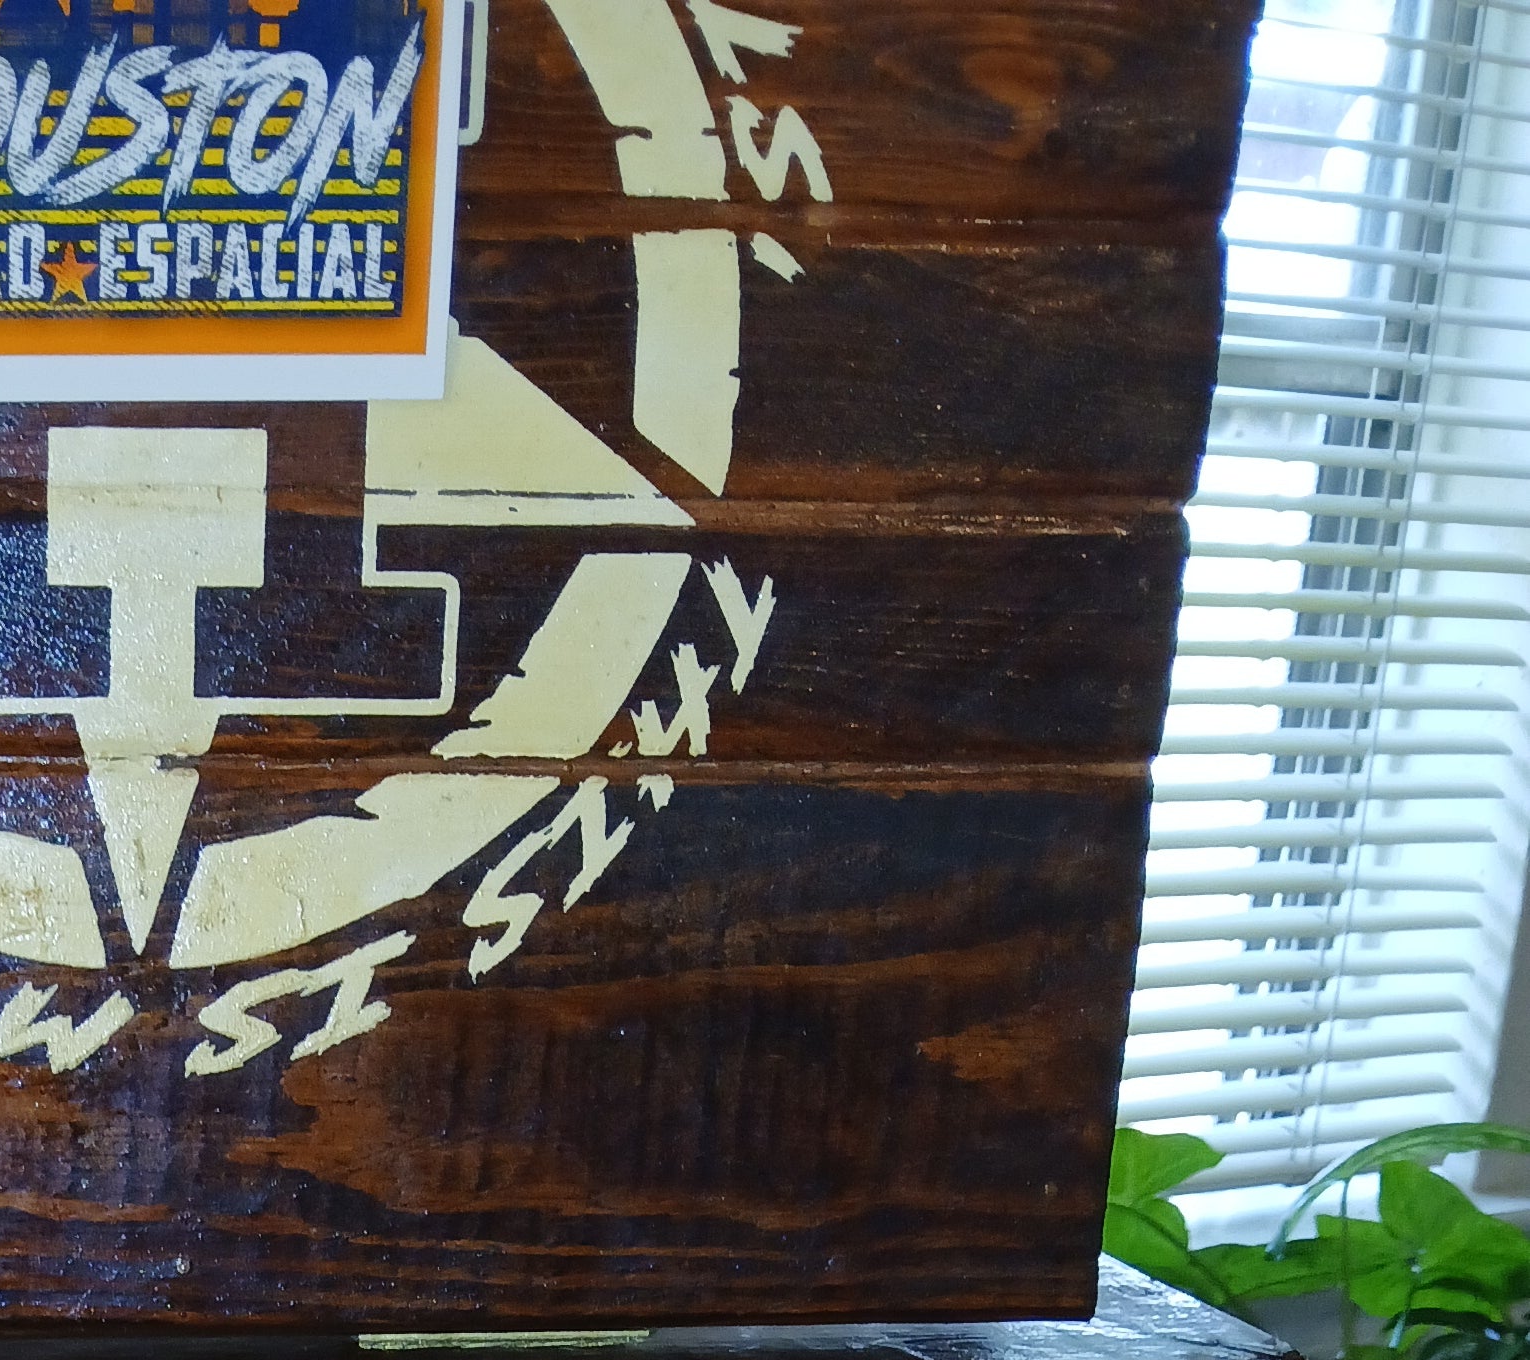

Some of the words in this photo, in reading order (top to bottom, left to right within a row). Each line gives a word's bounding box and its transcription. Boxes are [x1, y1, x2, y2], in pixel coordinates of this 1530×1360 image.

[98, 222, 395, 301] ESPACIAL
[461, 555, 777, 985] THIS
[184, 929, 417, 1078] IS
